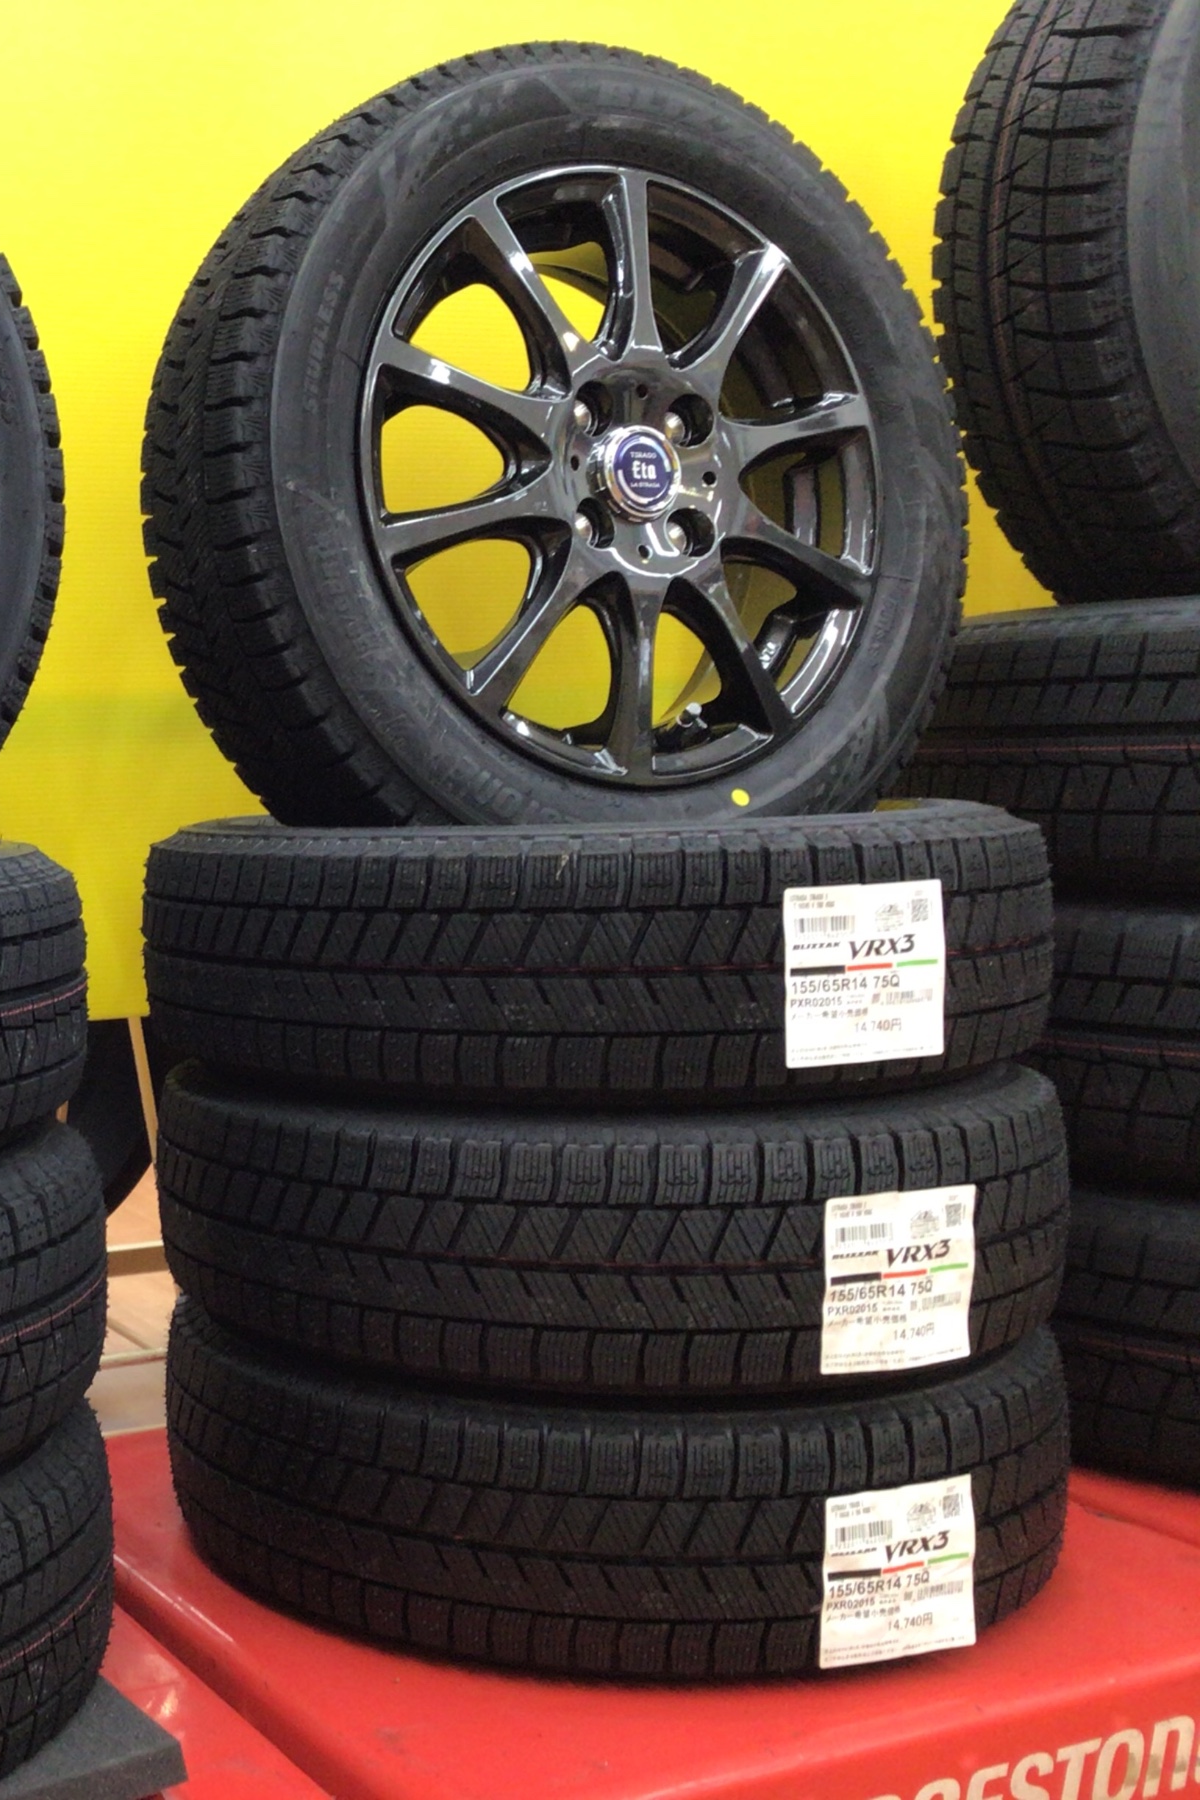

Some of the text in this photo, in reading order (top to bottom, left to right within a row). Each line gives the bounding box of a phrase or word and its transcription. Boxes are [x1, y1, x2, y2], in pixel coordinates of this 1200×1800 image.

[848, 934, 916, 960] VRX3
[791, 974, 901, 995] 155/65R14 75Q
[790, 997, 843, 1009] PXR02015
[854, 1018, 902, 1032] 14740円
[886, 1239, 951, 1269] VRX3
[830, 1279, 933, 1303] 155/65R14 75Q
[827, 1303, 878, 1317] PXR02015
[884, 1529, 951, 1564] VRX3
[828, 1570, 930, 1599] 155/65R14 75Q
[826, 1598, 876, 1612] PXR02015
